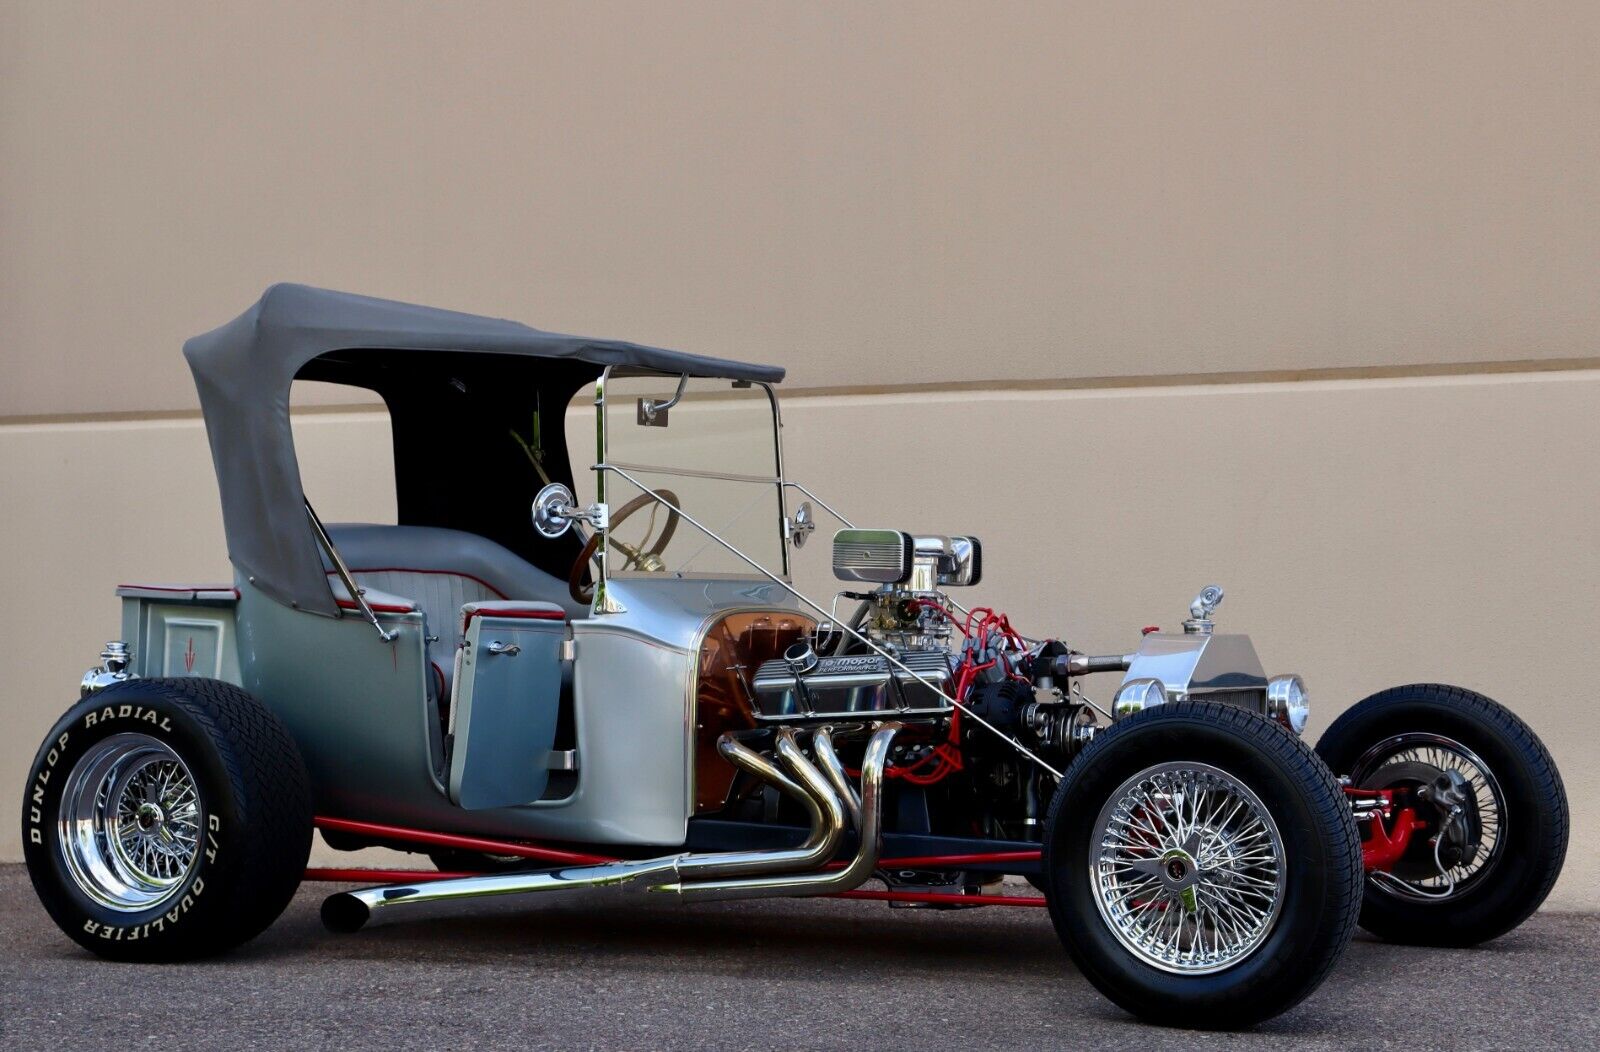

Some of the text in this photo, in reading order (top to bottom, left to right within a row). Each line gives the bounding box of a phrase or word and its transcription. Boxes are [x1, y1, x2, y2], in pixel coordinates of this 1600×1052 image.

[31, 704, 173, 845] DUNLOP RADIAL
[83, 813, 220, 941] G/T QUALIFIER
